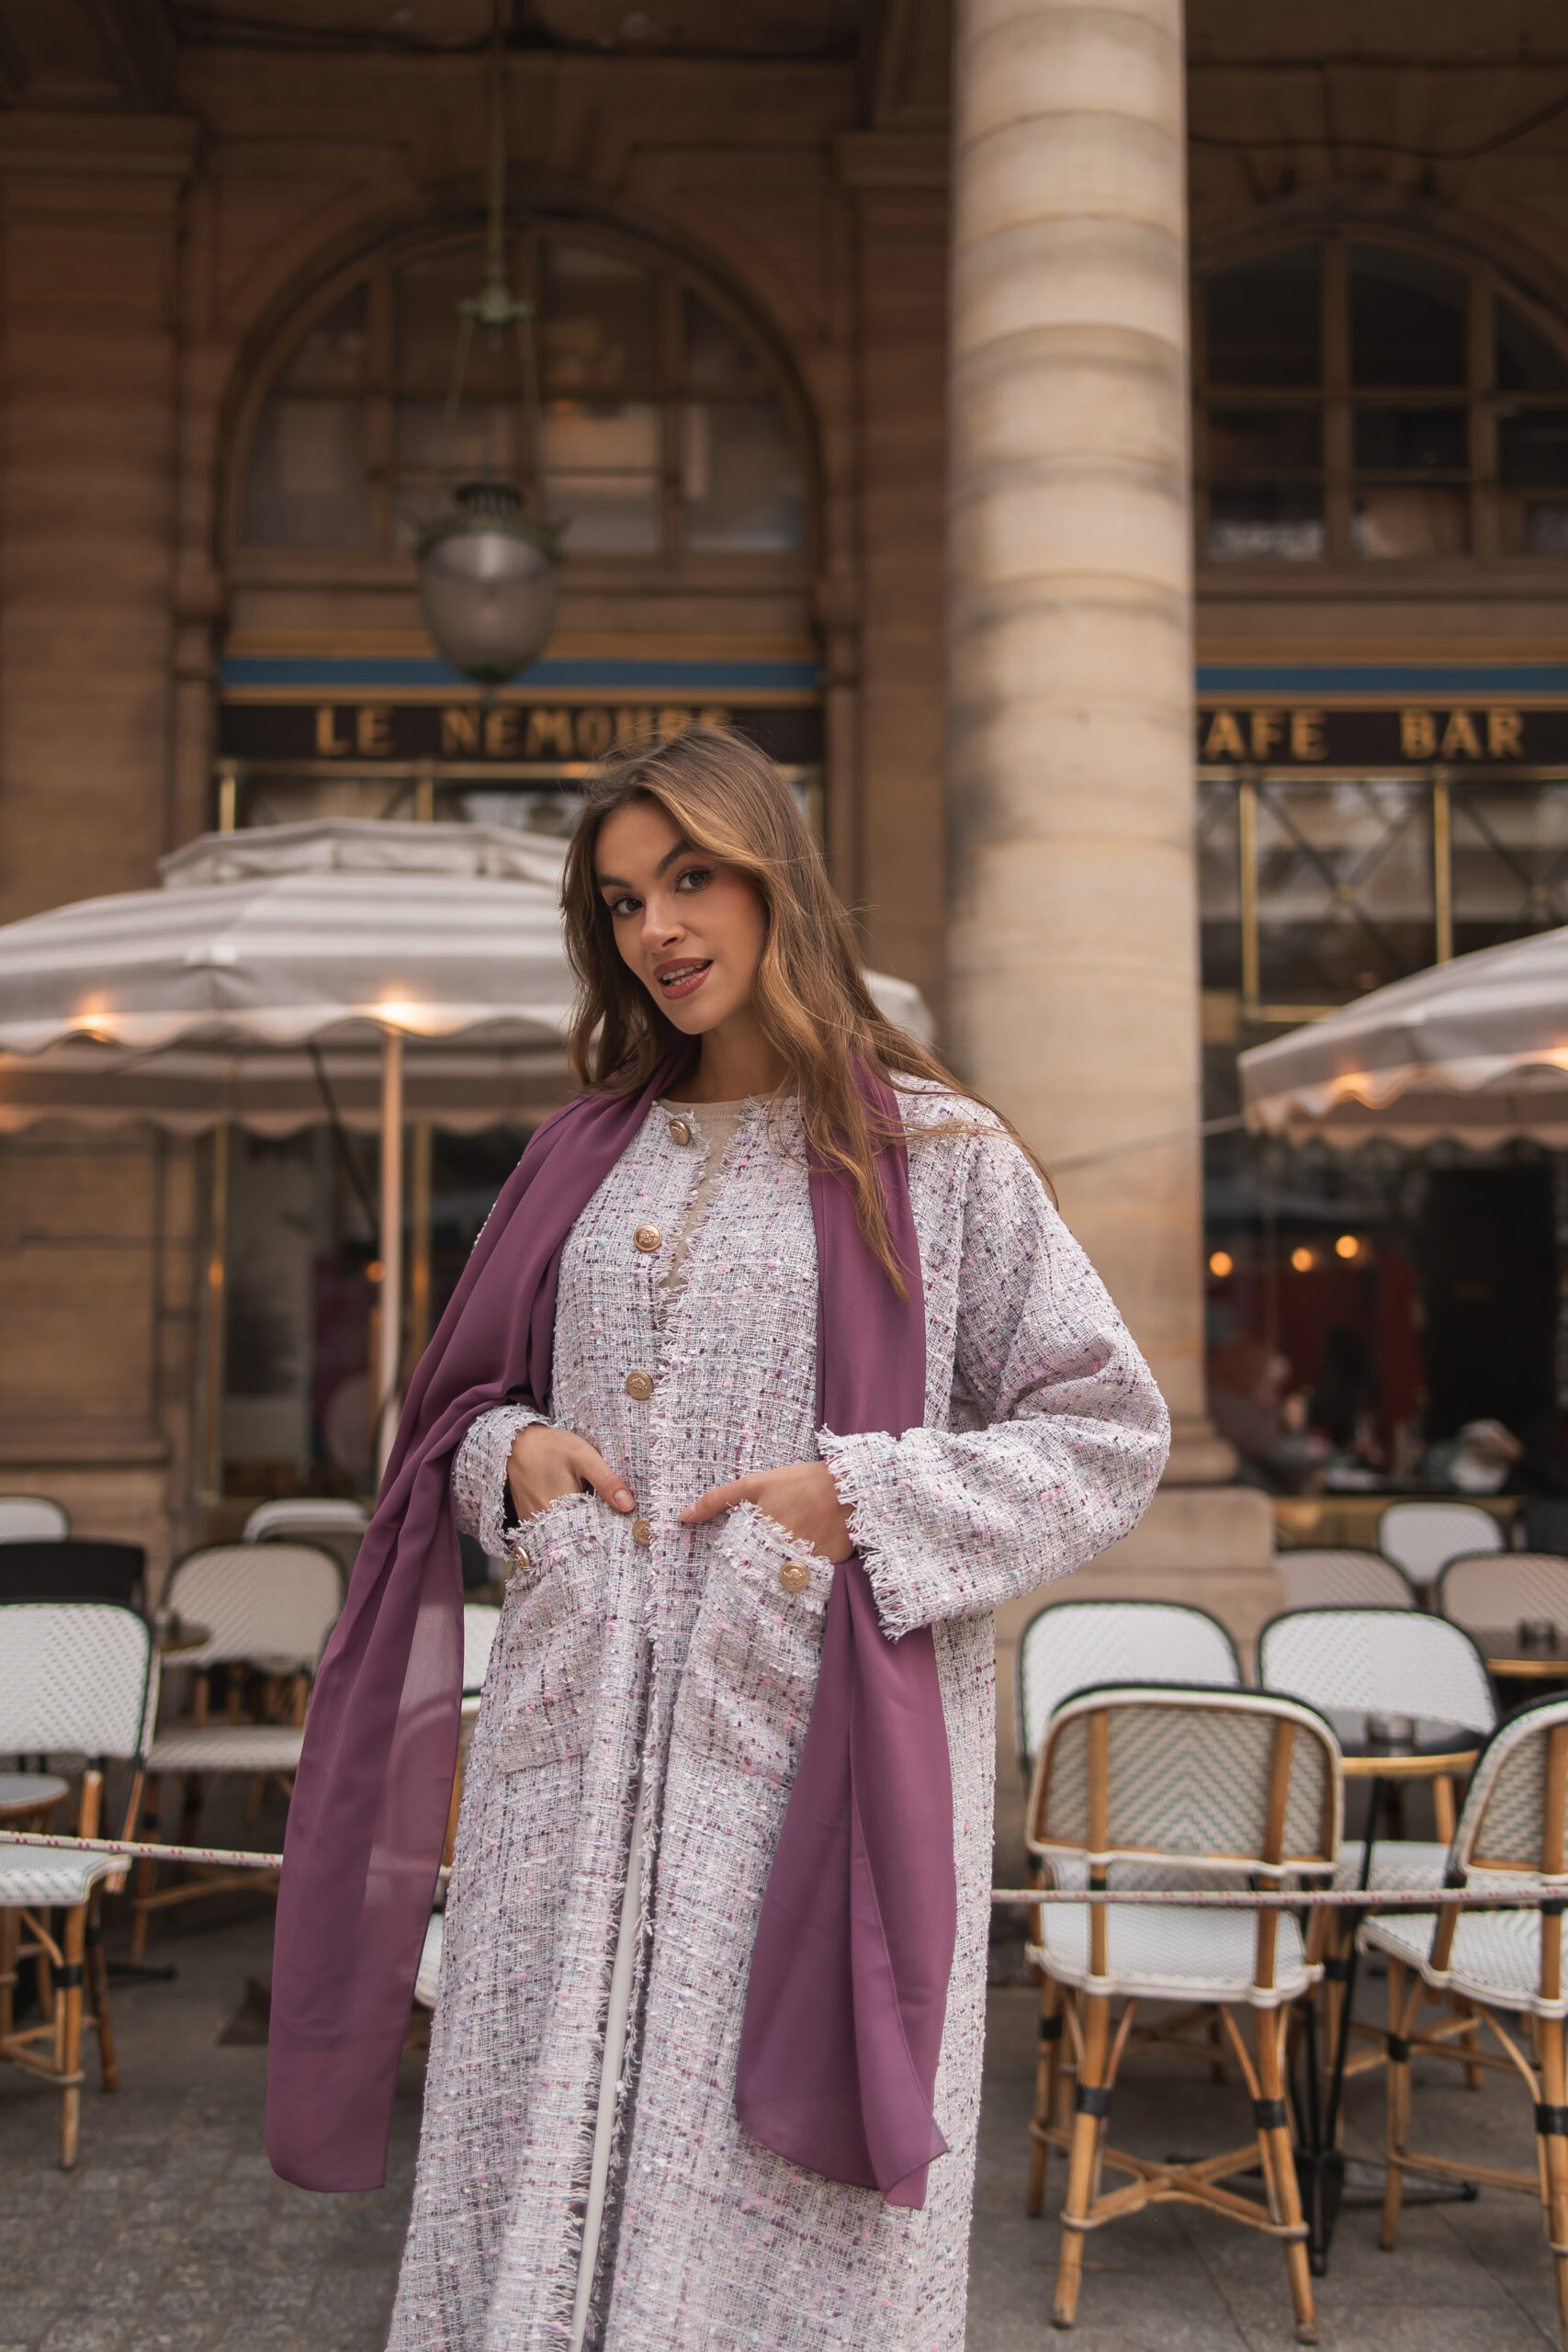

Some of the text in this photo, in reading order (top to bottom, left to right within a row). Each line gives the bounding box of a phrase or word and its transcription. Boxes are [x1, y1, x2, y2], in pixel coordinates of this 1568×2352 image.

[315, 705, 394, 756] LE
[1197, 707, 1524, 760] AFE BAR
